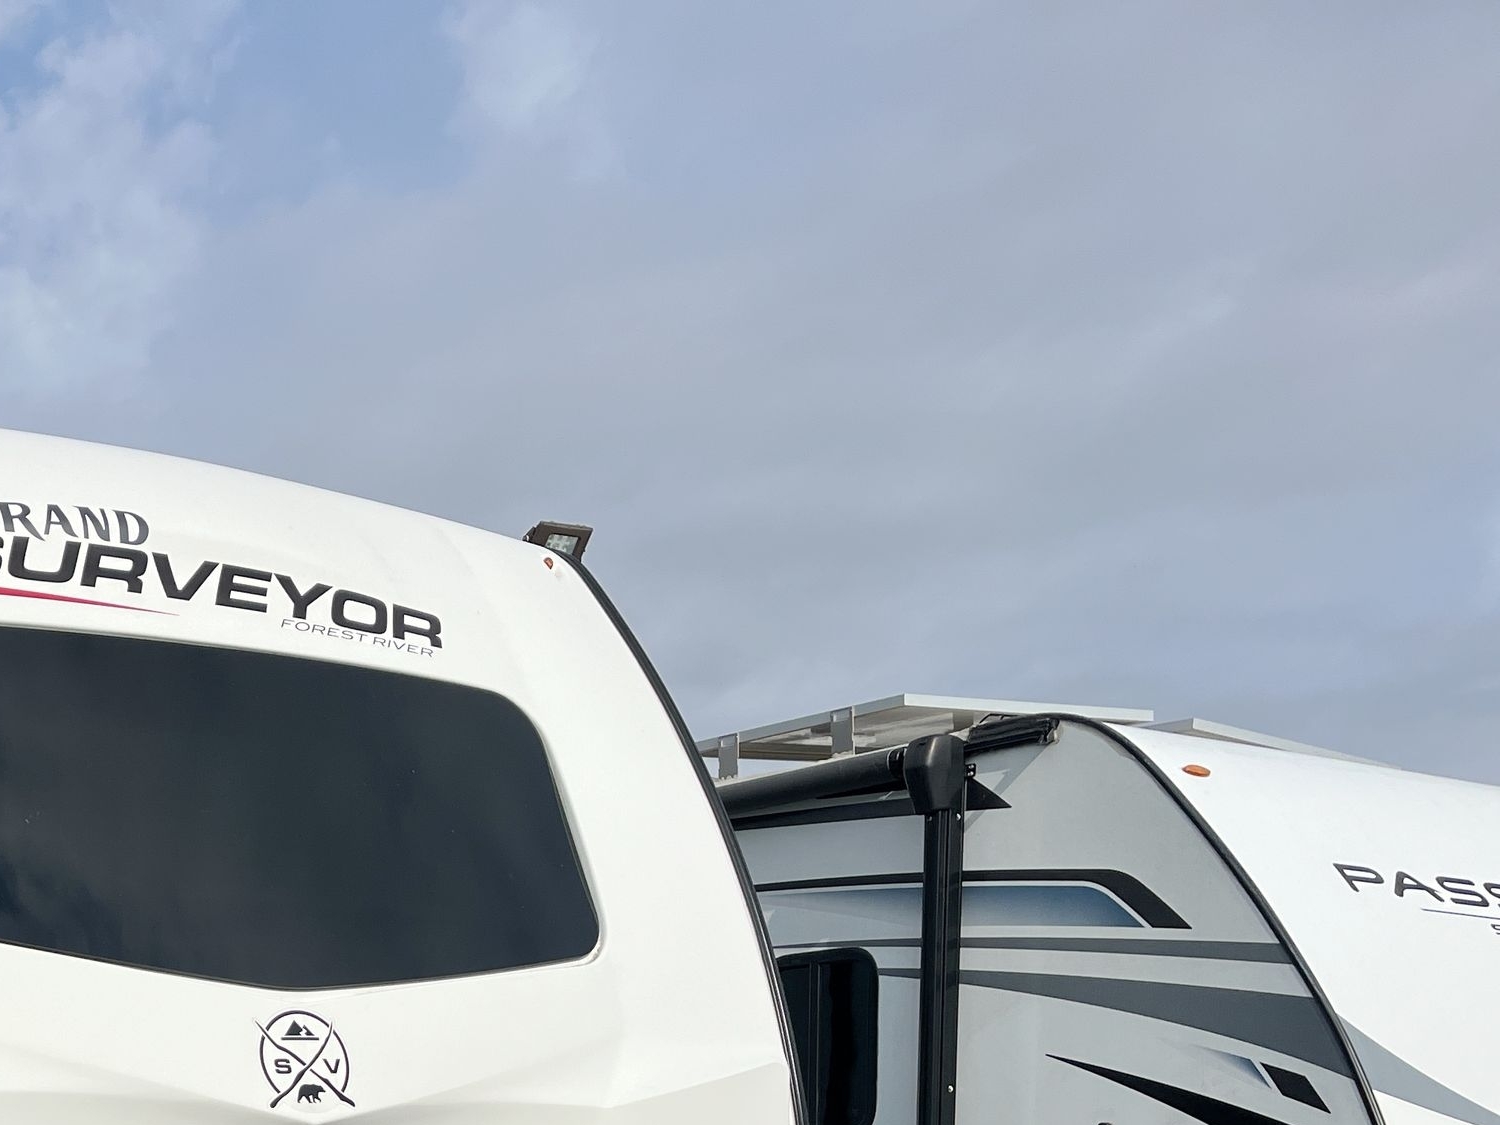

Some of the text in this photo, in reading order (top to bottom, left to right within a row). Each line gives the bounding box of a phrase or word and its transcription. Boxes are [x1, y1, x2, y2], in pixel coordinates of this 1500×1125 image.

[281, 618, 435, 658] FOREST RIVER
[273, 1058, 341, 1074] S V
